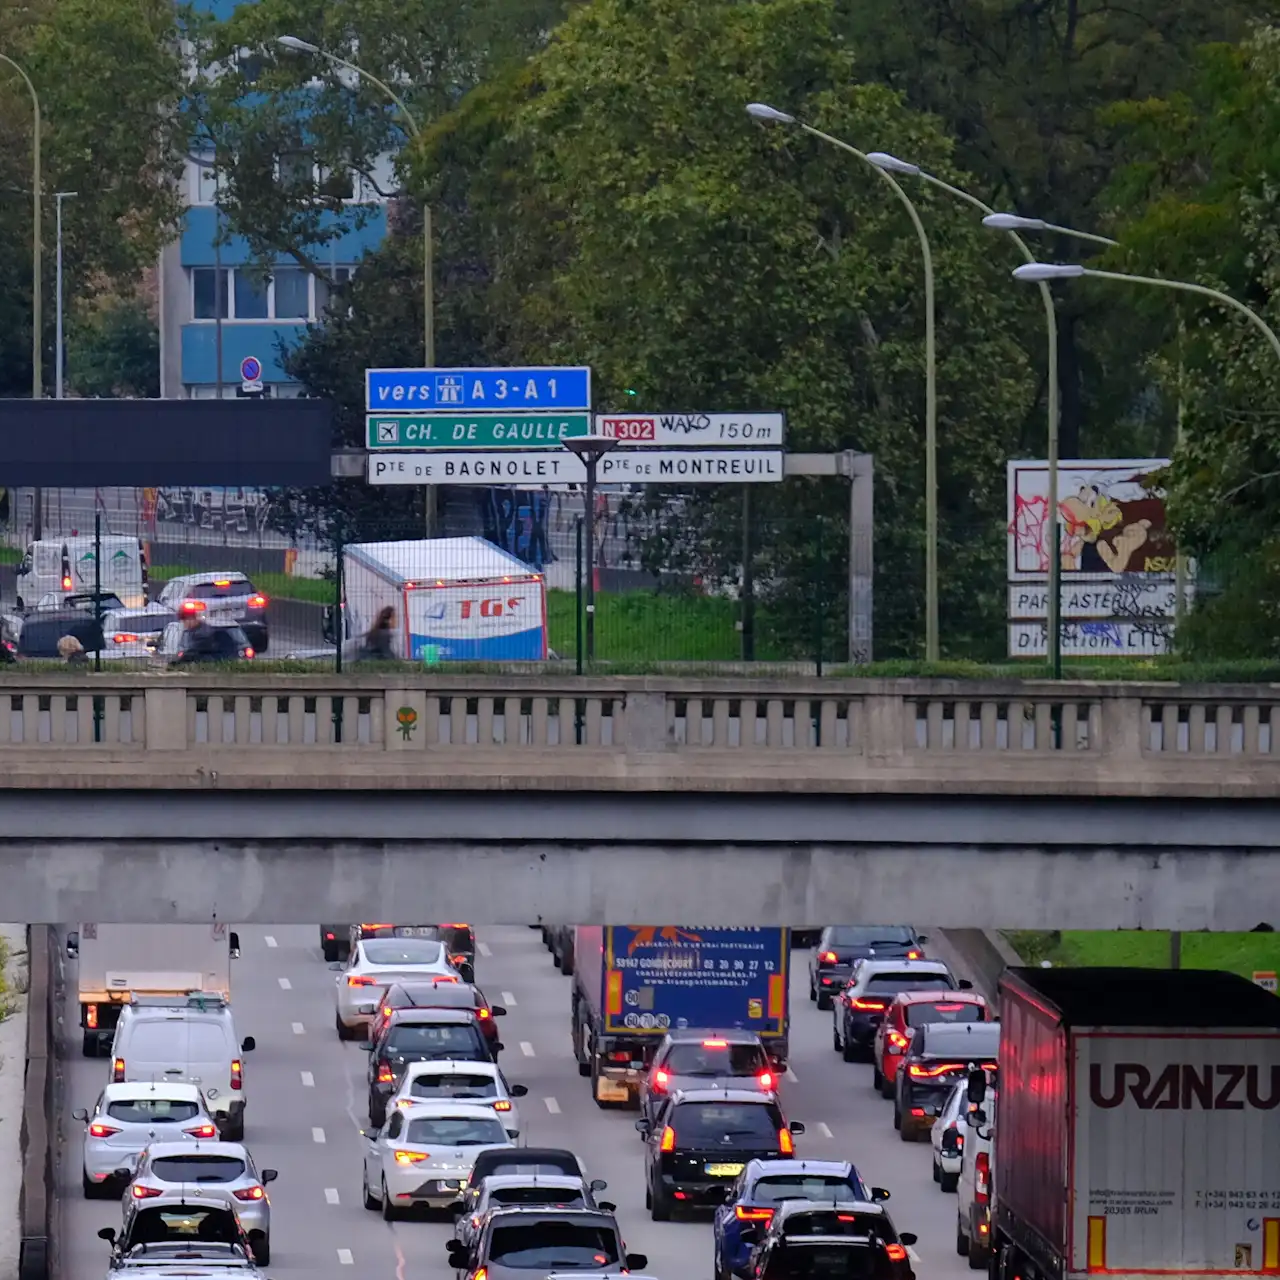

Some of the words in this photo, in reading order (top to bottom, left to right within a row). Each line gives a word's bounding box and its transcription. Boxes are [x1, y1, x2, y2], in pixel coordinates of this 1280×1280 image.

[378, 384, 430, 400] vers
[406, 424, 437, 440] CH.
[452, 424, 478, 439] DE
[492, 422, 569, 439] GAULLE
[415, 466, 432, 476] DE
[445, 461, 560, 475] BAGNOLET
[636, 465, 651, 474] DE
[660, 459, 775, 474] MONTREUIL
[1089, 1063, 1280, 1110] URANZU
